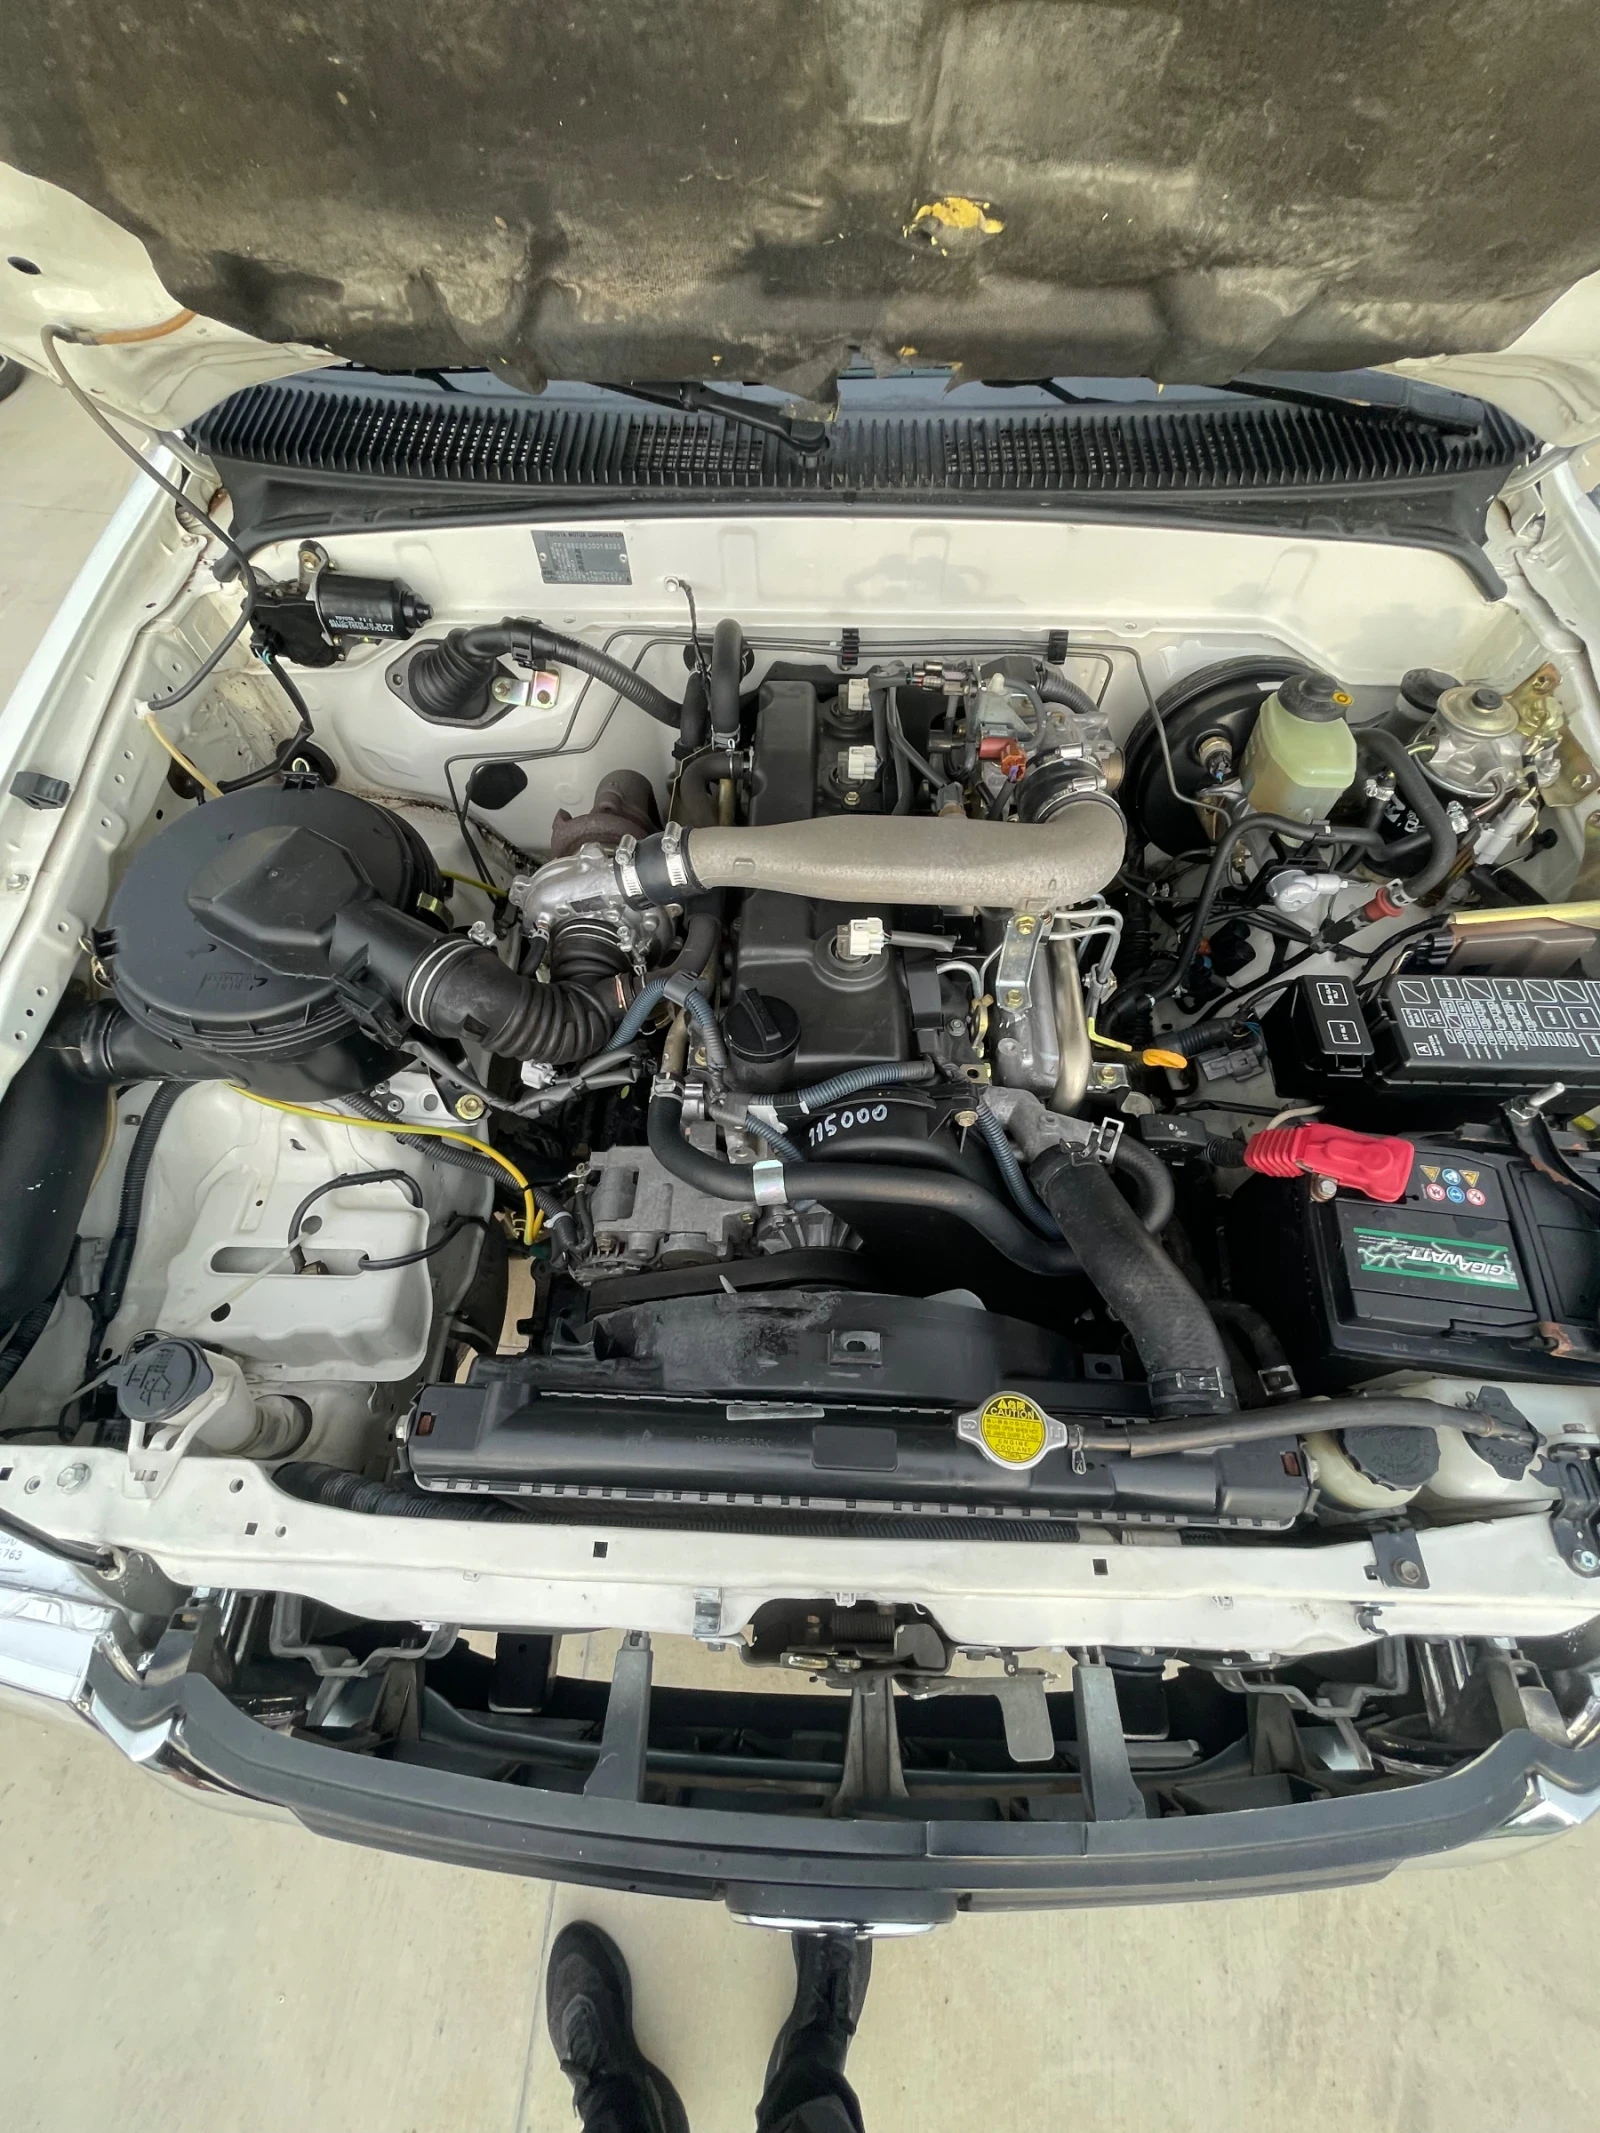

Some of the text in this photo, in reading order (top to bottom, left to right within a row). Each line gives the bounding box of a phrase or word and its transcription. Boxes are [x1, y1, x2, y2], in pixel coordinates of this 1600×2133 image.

[809, 1104, 888, 1147] 115000
[1406, 1248, 1505, 1276] GIGAWATT
[990, 1407, 1035, 1420] CAUTION
[995, 1444, 1032, 1453] COOLANT
[997, 1439, 1029, 1447] ENGINE
